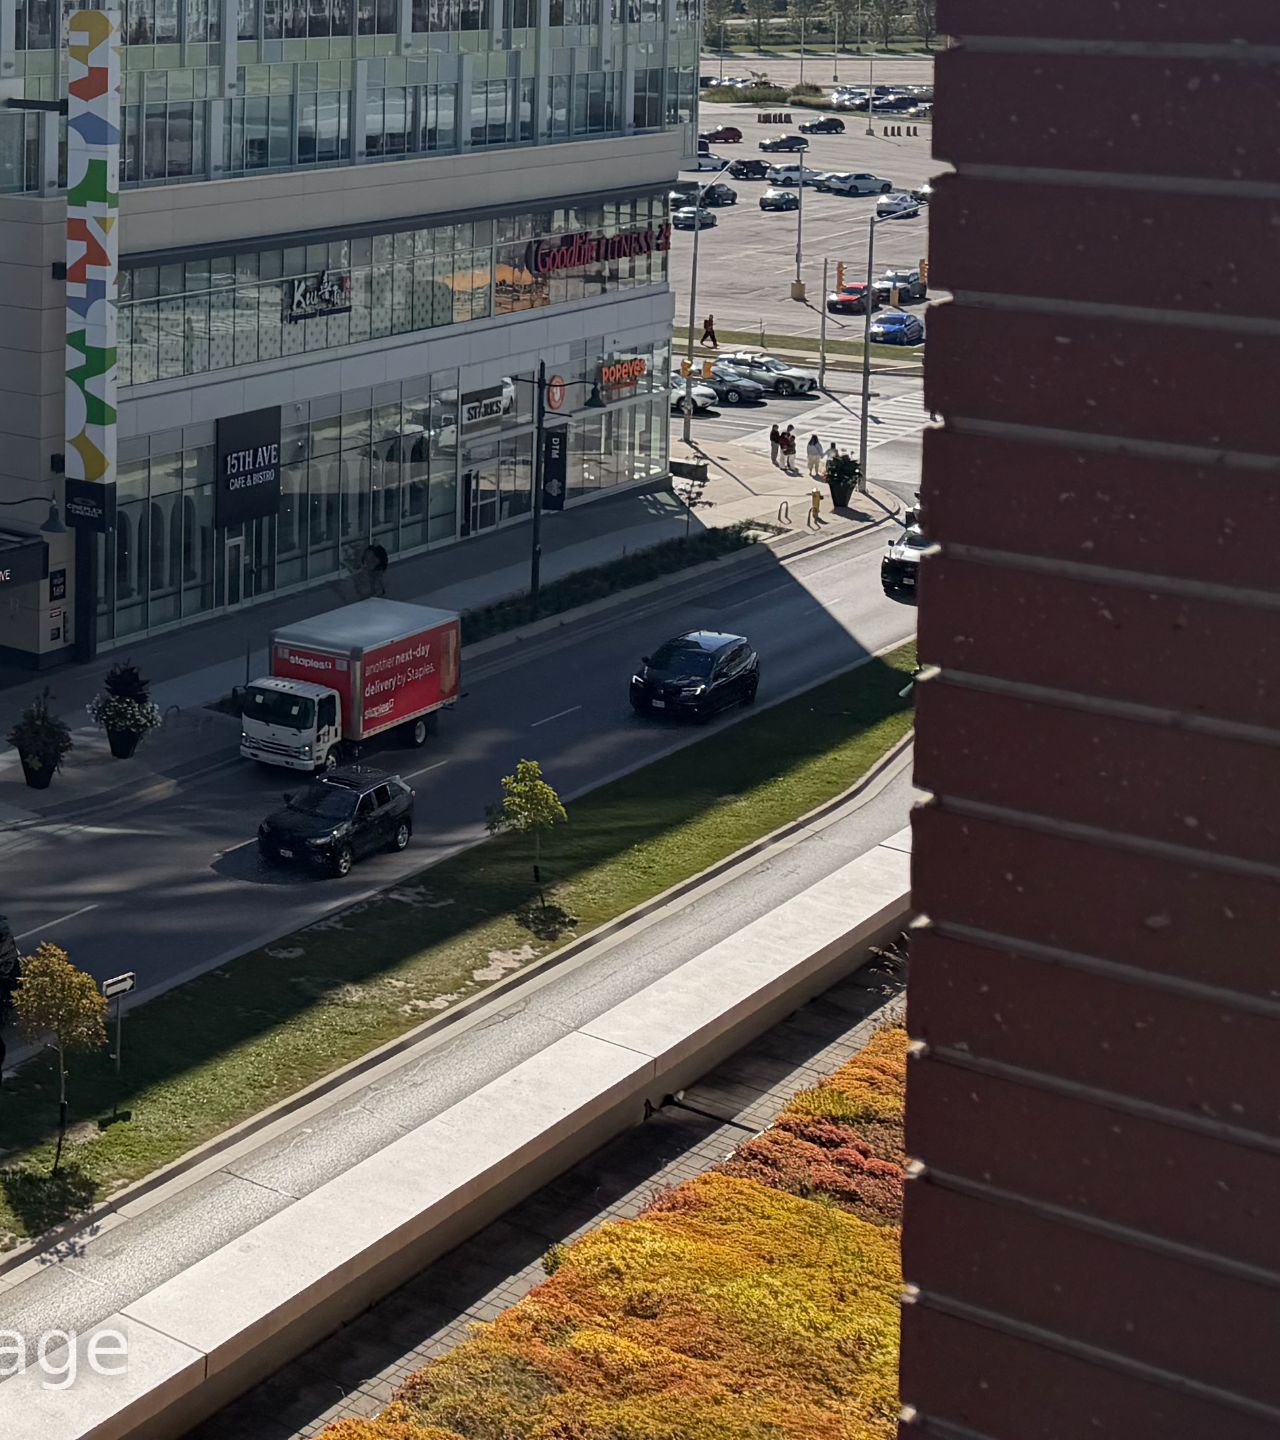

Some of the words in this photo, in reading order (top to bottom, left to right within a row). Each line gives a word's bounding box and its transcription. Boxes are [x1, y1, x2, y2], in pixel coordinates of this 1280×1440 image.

[227, 449, 253, 475] 15TH
[255, 444, 278, 468] AVE
[365, 656, 395, 677] another
[395, 643, 431, 665] next-day
[365, 677, 397, 697] delivery
[397, 673, 406, 687] by
